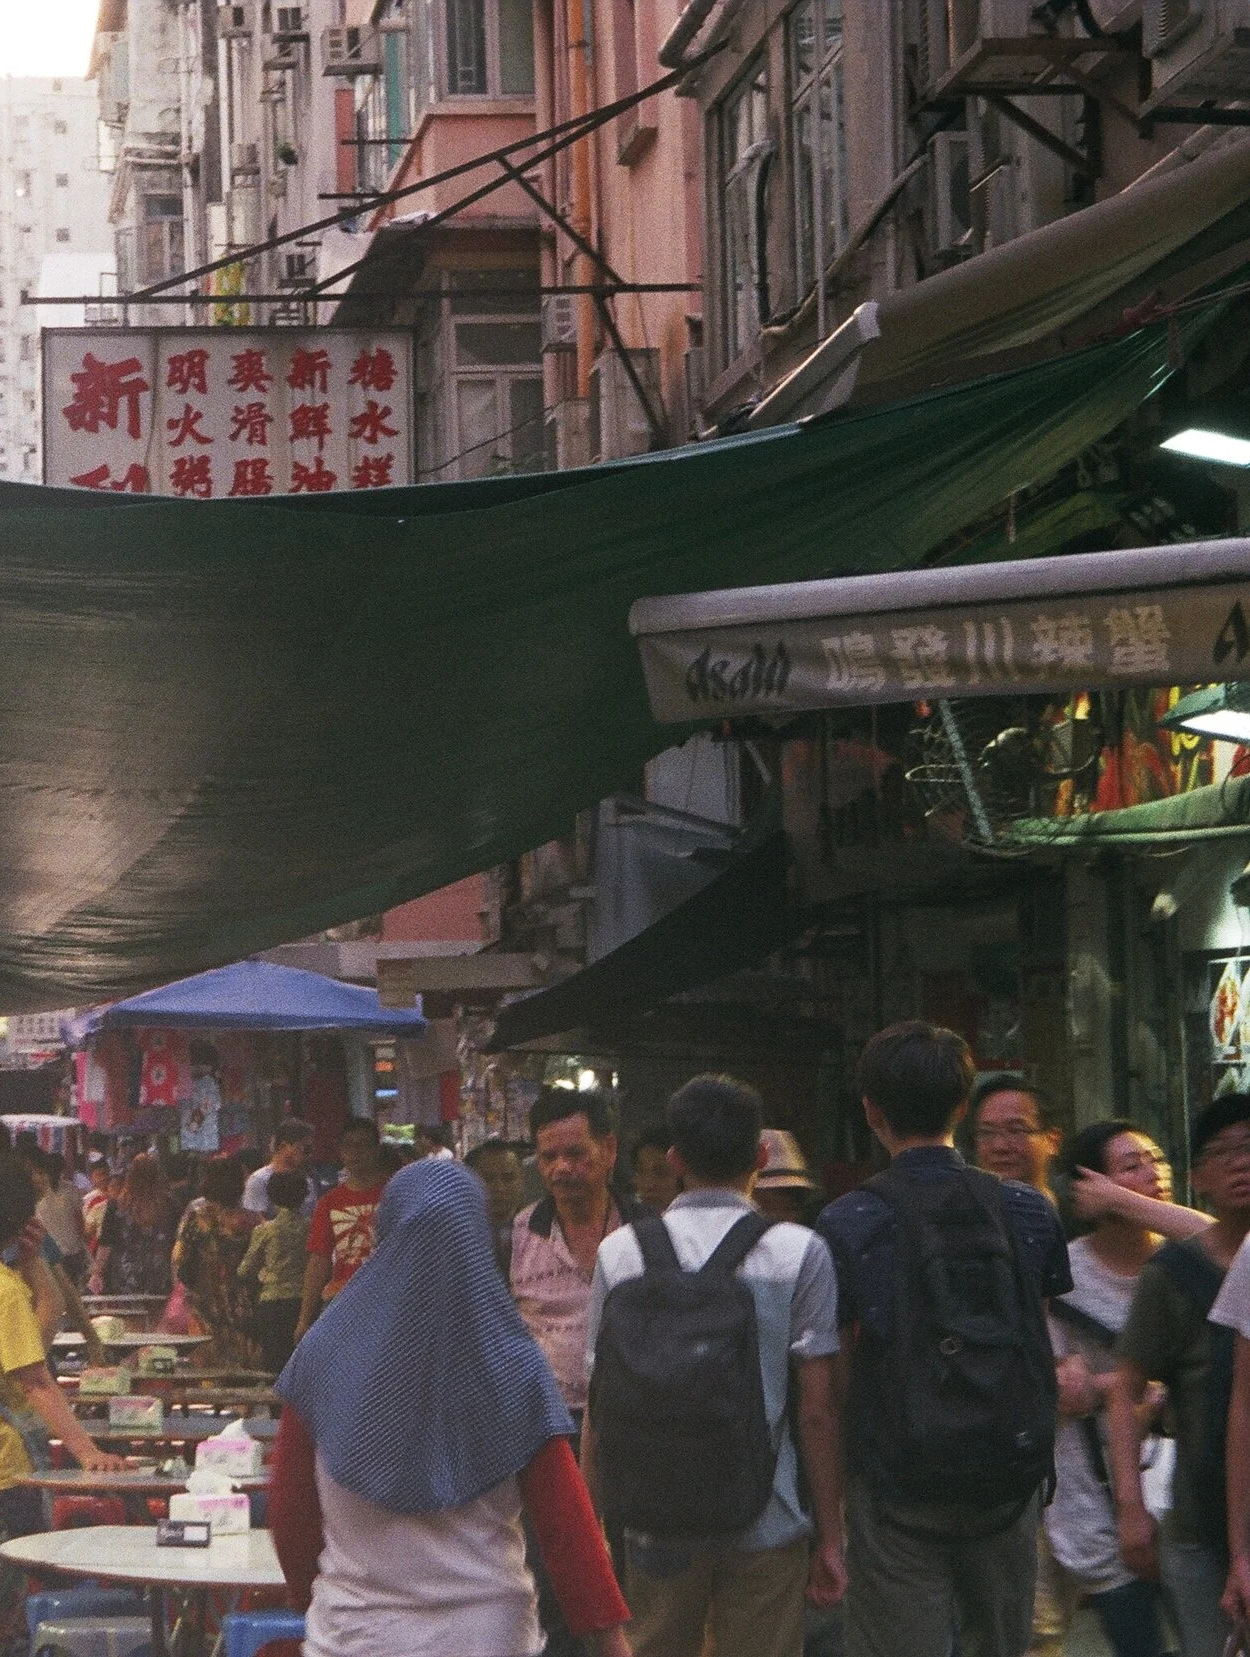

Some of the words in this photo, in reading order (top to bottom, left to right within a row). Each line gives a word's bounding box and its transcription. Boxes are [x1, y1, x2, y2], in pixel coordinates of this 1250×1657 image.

[62, 352, 149, 491] 新
[166, 348, 214, 498] 明火粥
